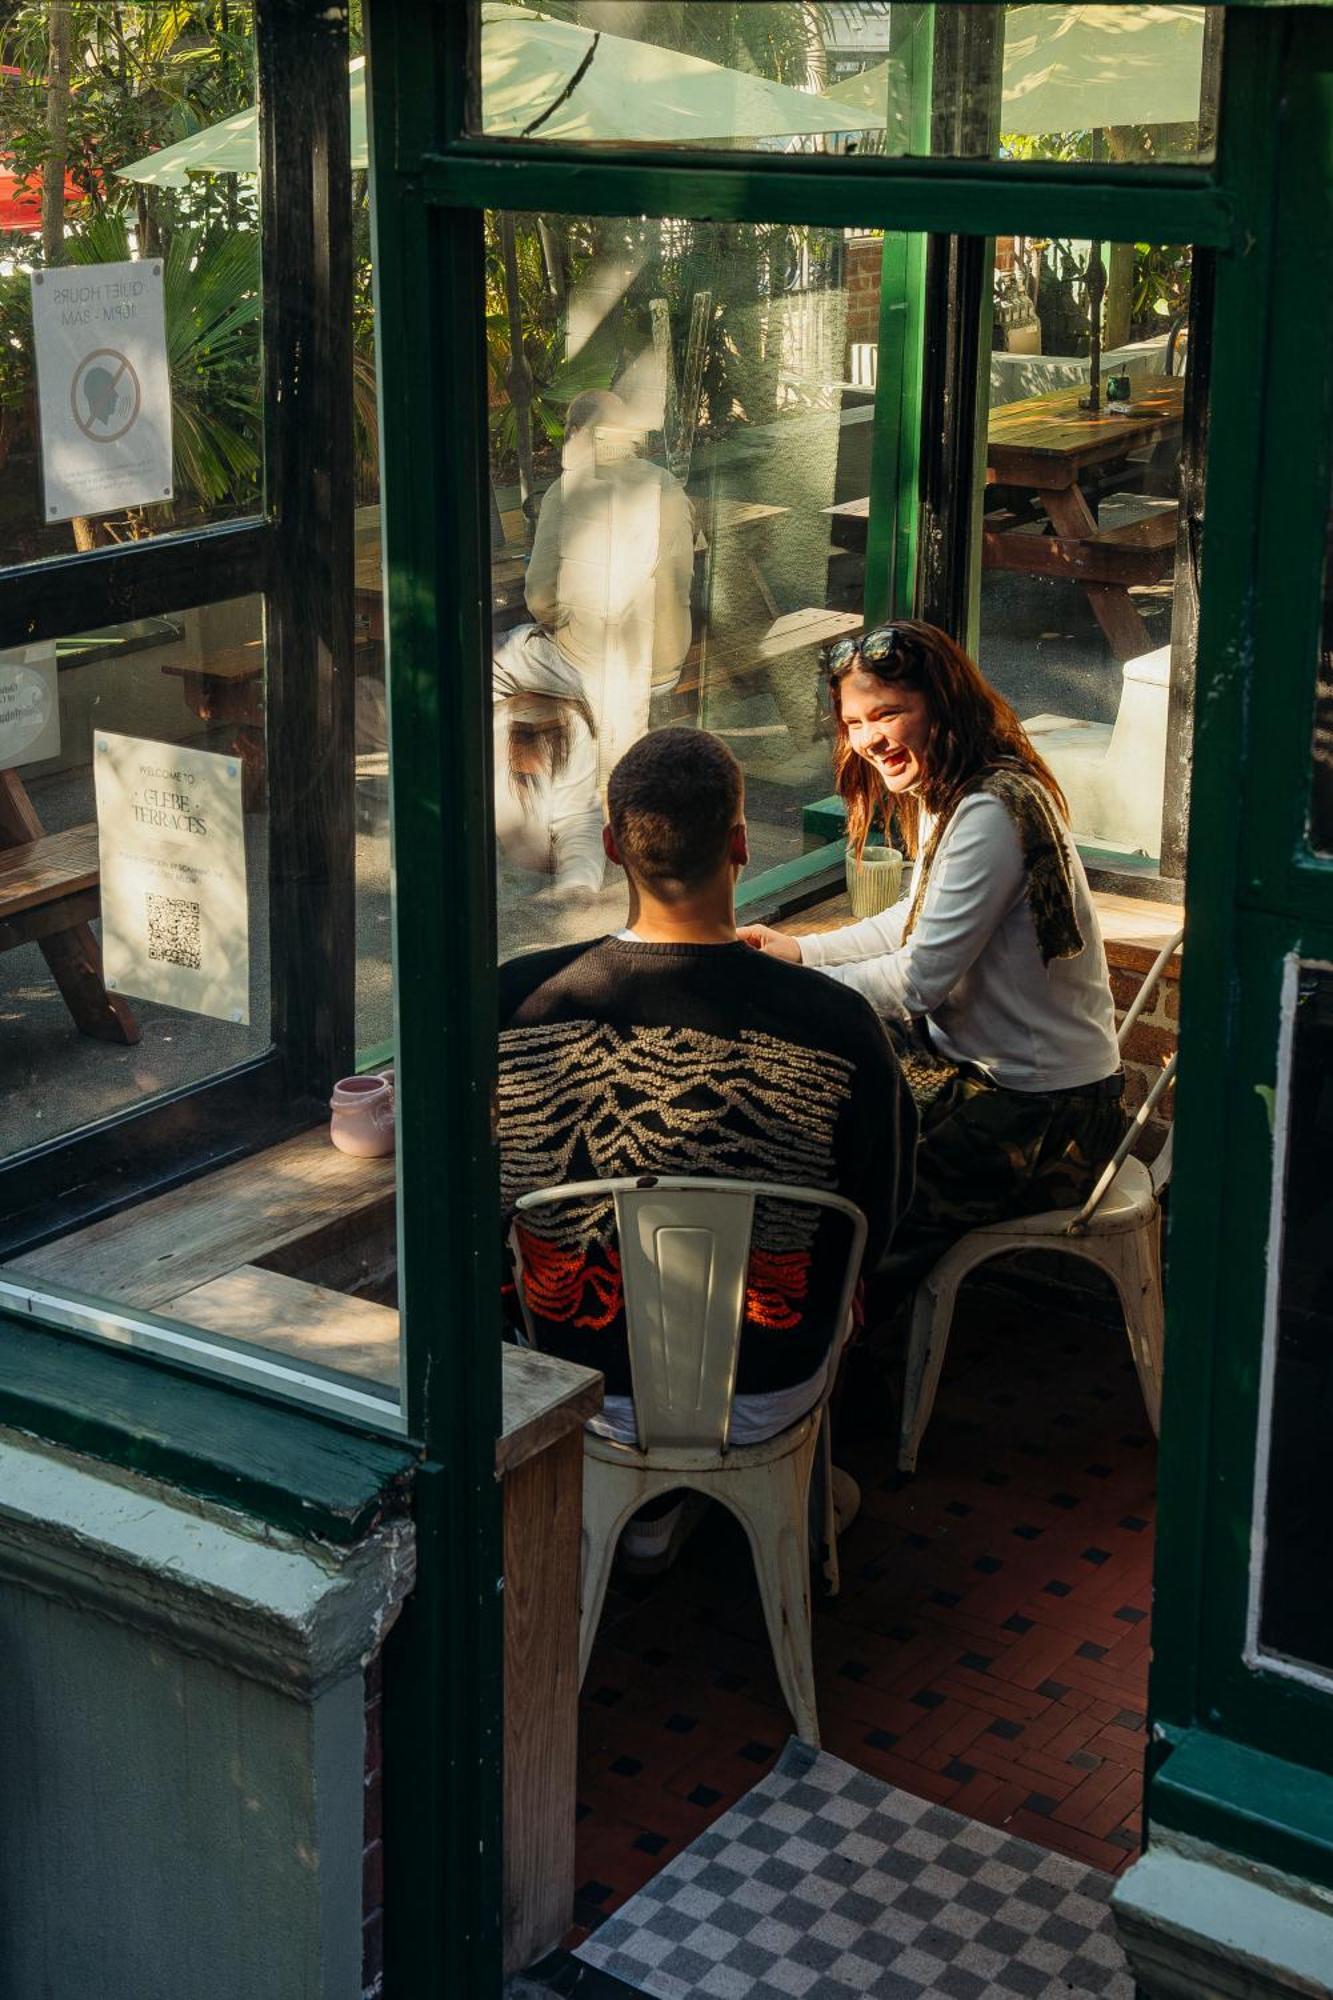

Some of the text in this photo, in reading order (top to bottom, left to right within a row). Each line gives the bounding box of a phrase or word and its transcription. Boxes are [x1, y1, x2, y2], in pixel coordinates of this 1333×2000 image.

[139, 766, 196, 785] WELCOME TO
[143, 788, 191, 813] GLEBE
[131, 804, 207, 836] TERRACES
